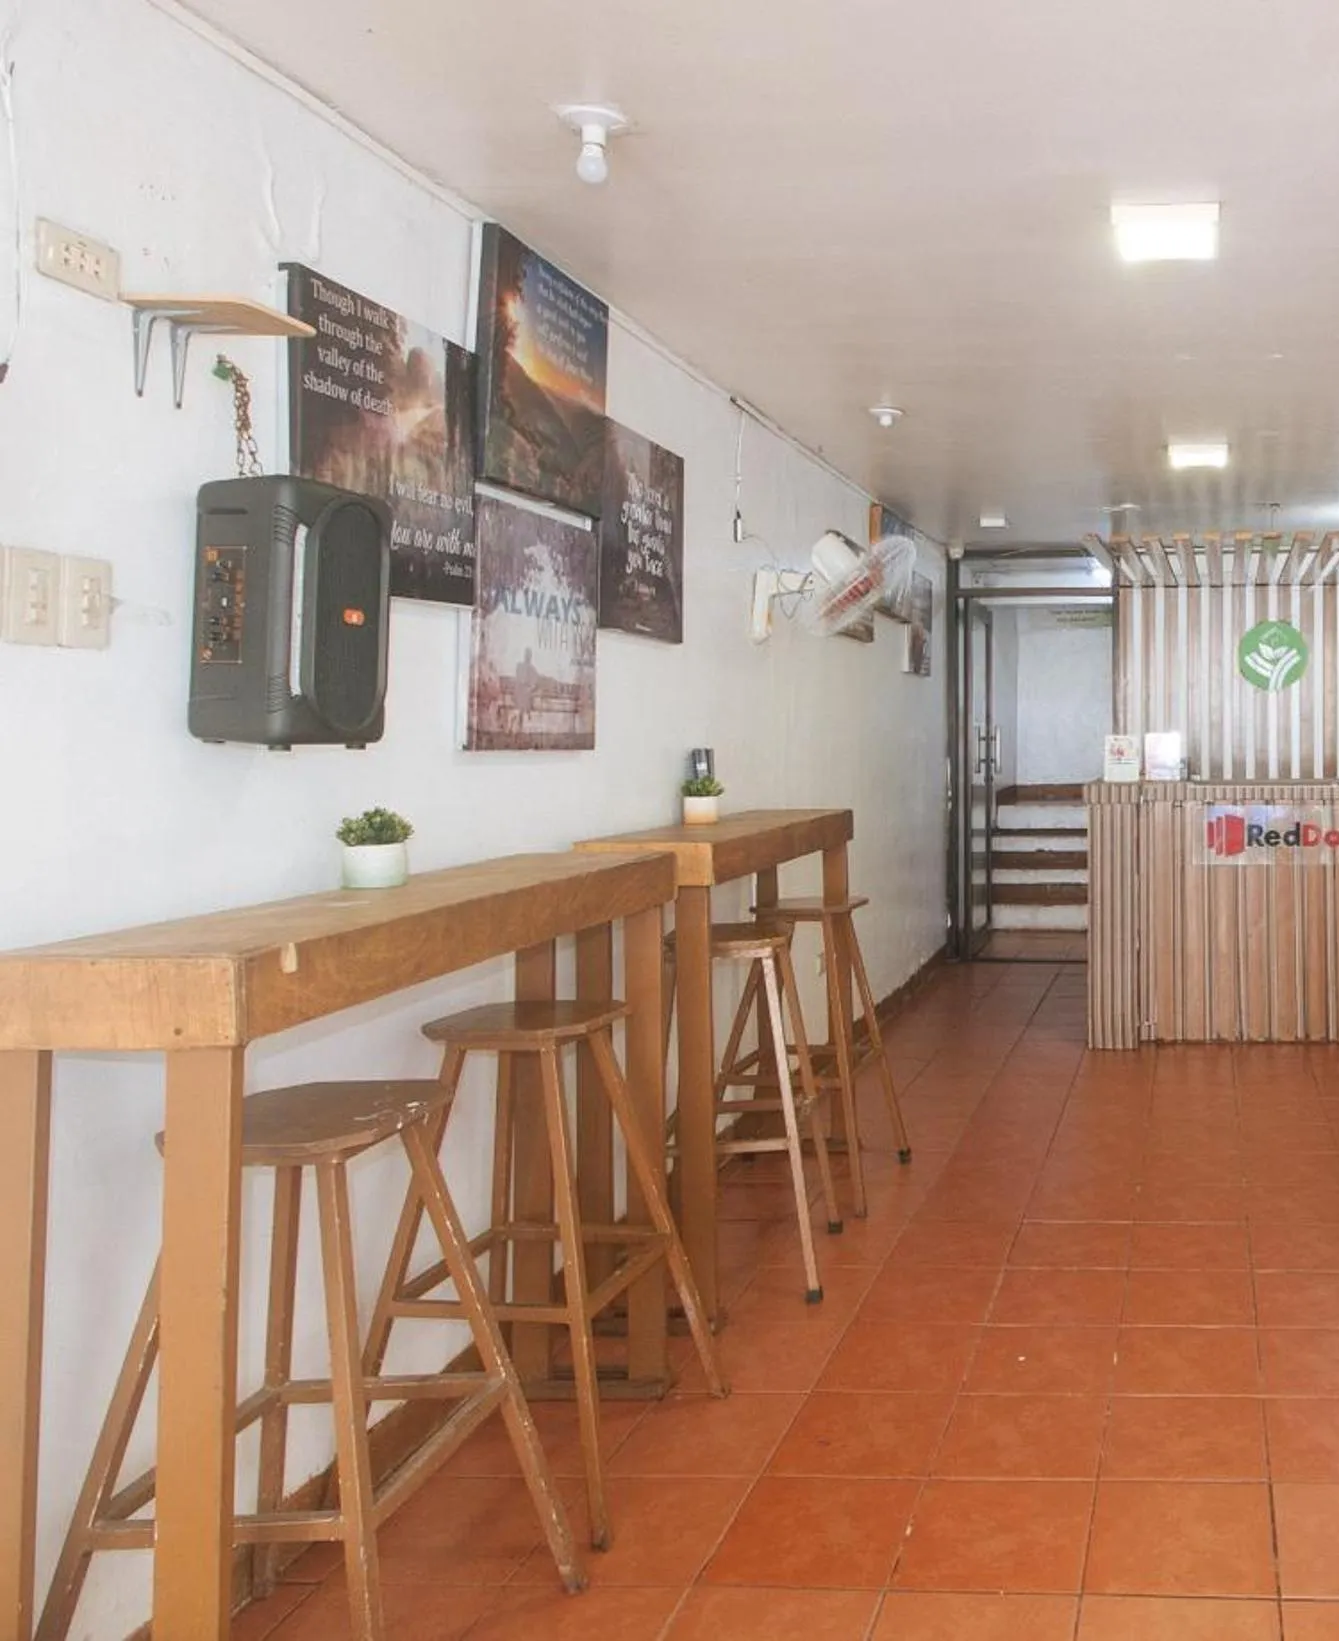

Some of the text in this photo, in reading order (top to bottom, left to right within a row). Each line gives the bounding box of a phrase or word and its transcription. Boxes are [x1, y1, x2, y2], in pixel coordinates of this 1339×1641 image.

[310, 278, 355, 317] Though
[363, 306, 390, 329] walk
[318, 313, 384, 356] through the
[316, 345, 385, 385] valley of the
[303, 371, 349, 401] shadow
[350, 388, 363, 410] of
[493, 585, 583, 626] ALWAYS
